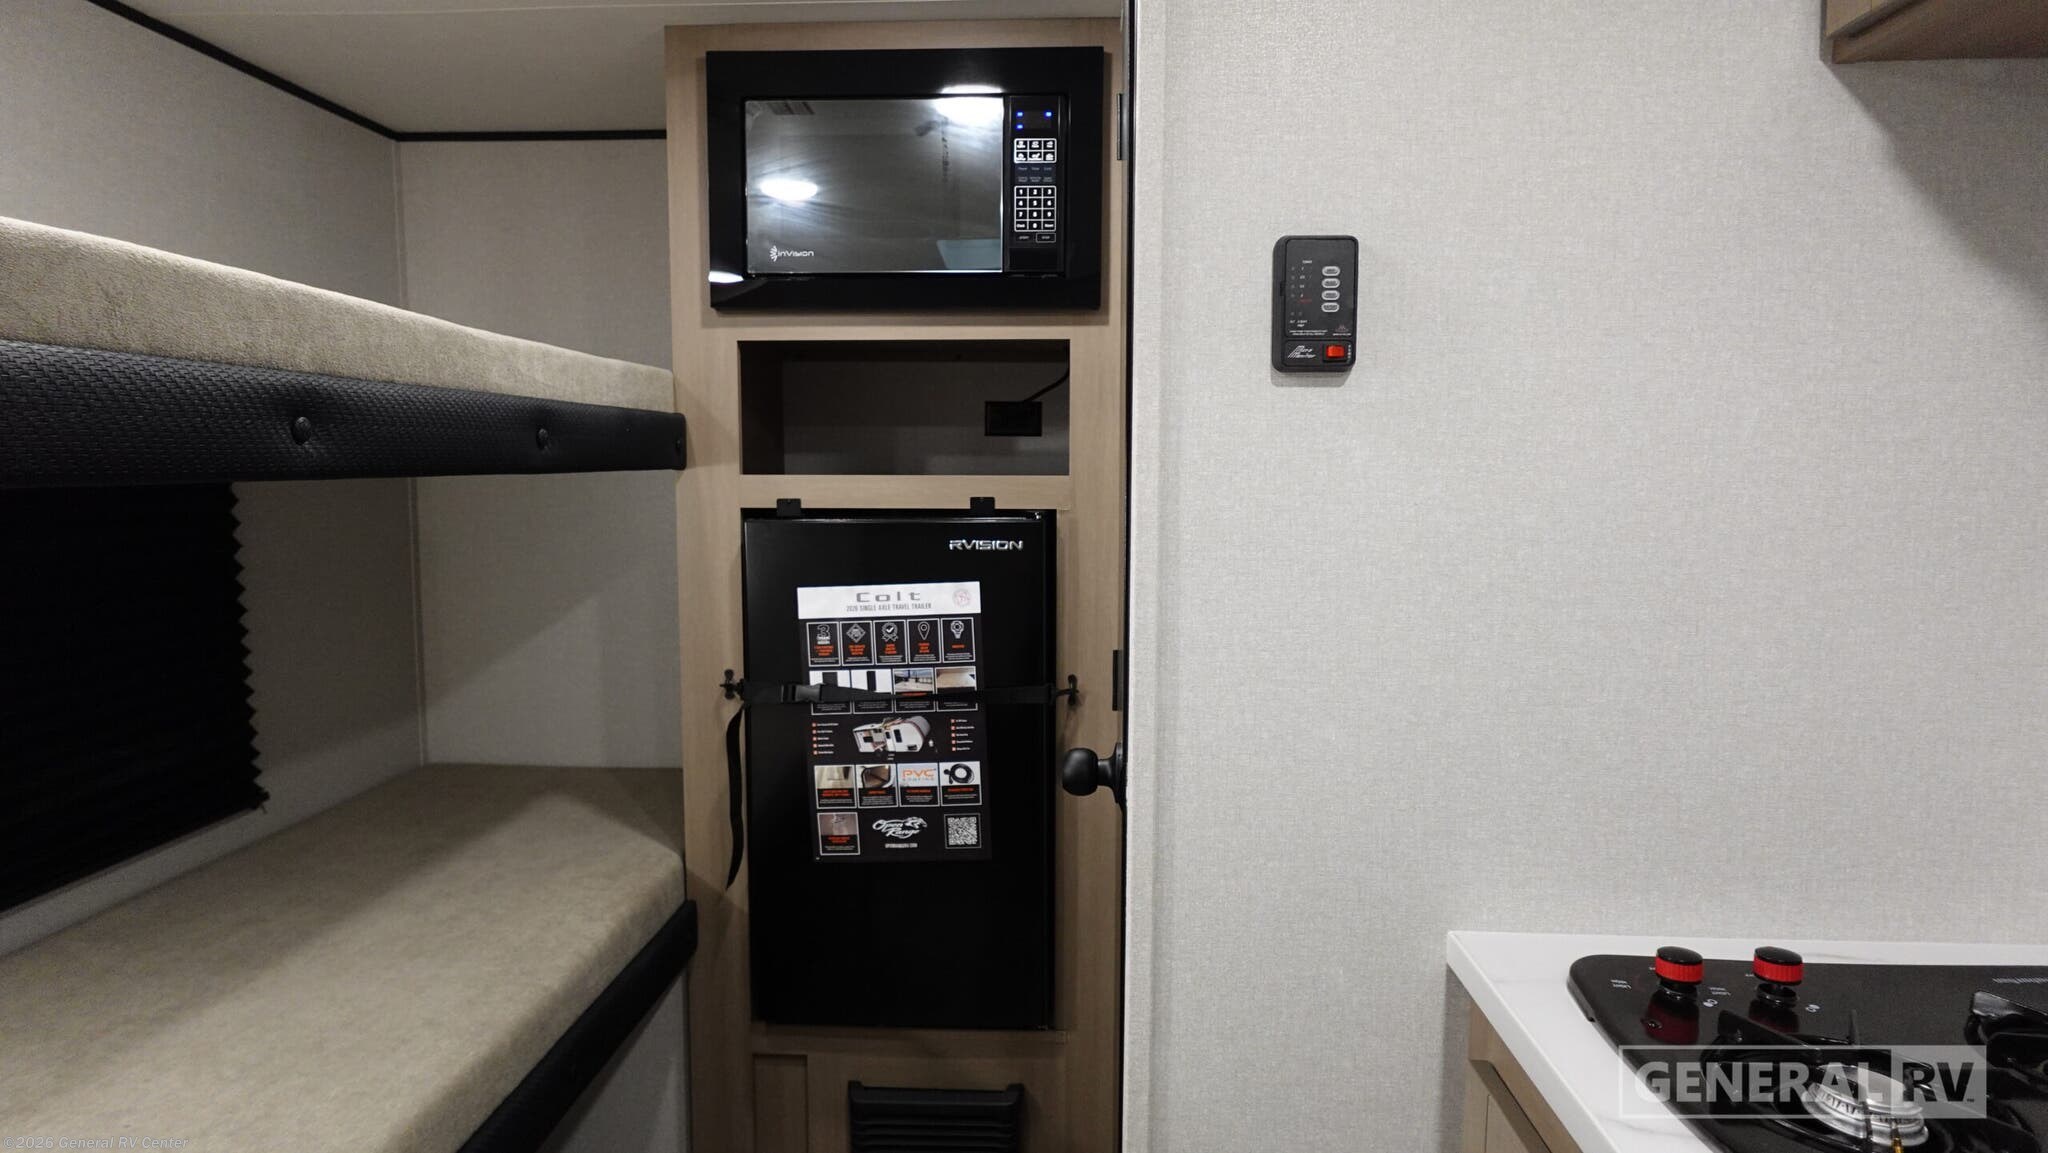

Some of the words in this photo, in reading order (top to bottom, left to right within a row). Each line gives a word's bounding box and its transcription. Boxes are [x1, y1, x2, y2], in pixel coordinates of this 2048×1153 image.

[949, 539, 1023, 550] RVISION
[856, 591, 921, 602] Colt
[902, 768, 935, 778] PVC
